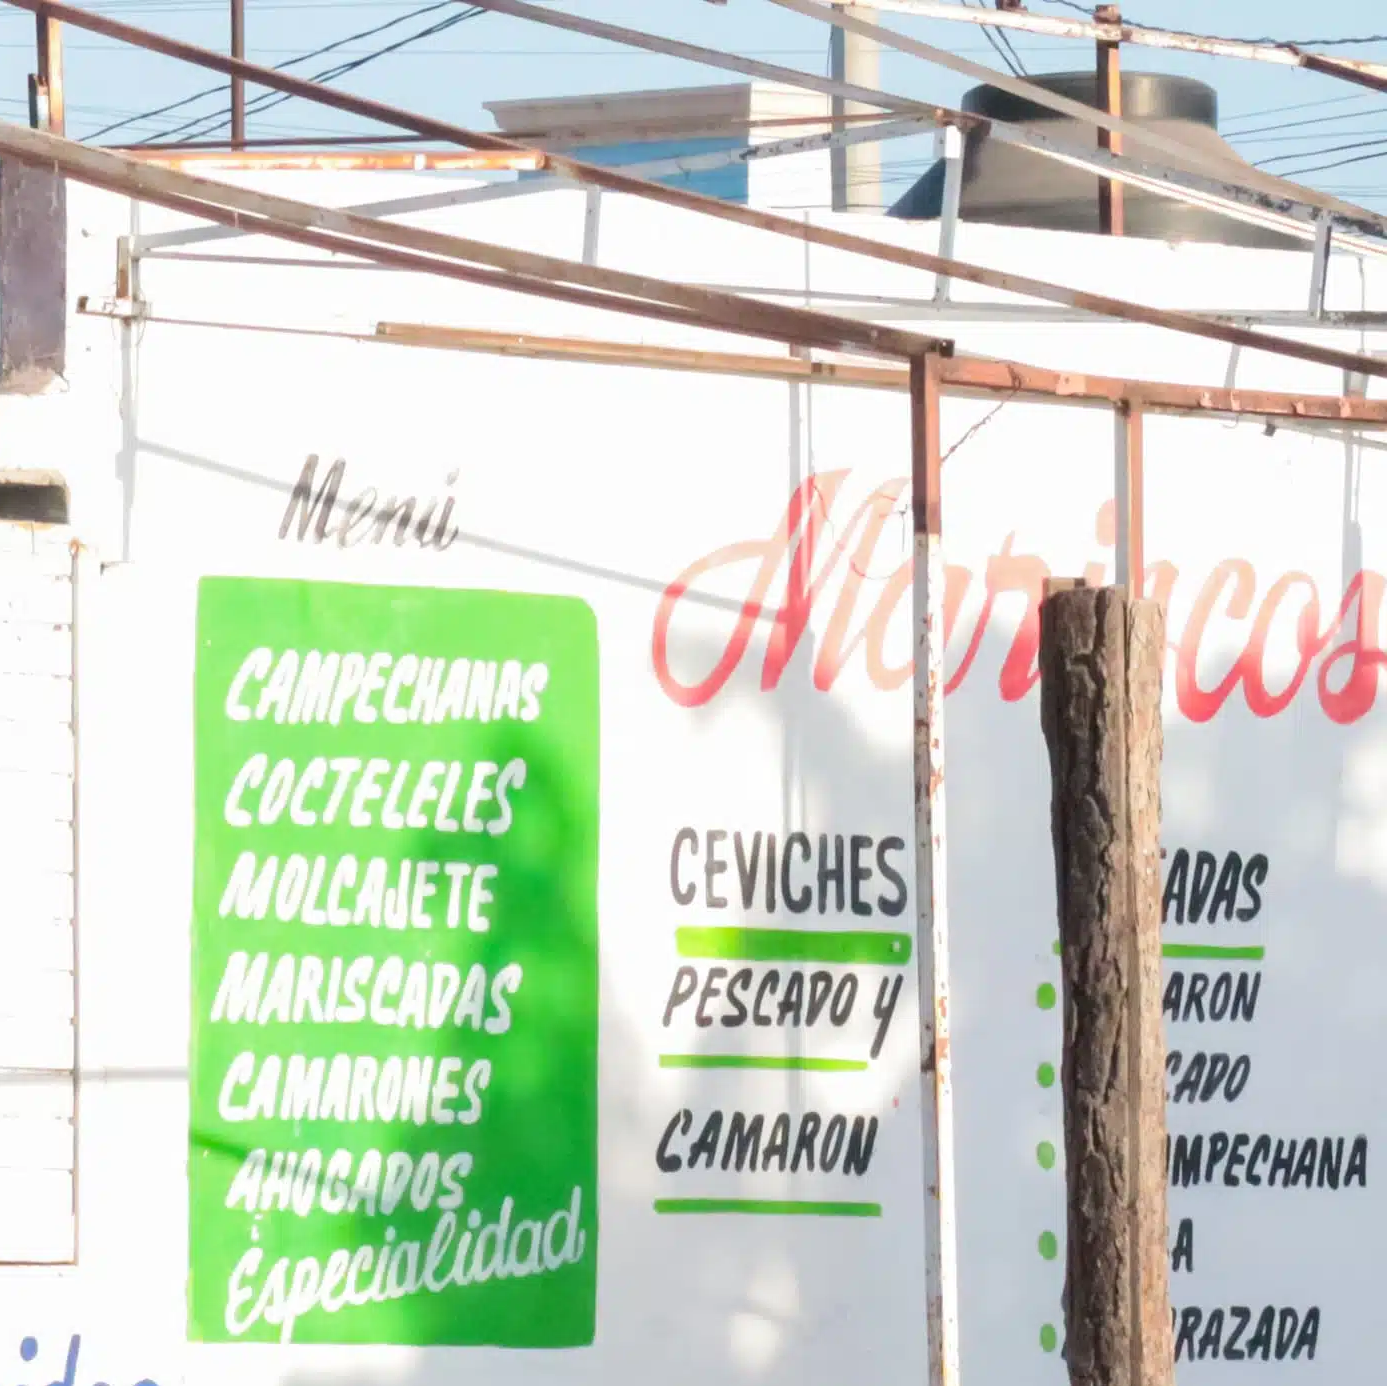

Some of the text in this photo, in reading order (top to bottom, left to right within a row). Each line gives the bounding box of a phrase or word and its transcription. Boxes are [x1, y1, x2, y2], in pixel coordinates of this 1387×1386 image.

[224, 646, 550, 726] CAMPECHANAS
[223, 752, 527, 836] COCTELELES
[218, 850, 498, 932] MOLCAJETE
[669, 827, 909, 917] CEVICHES
[209, 949, 523, 1034] MARISCADAS
[662, 966, 858, 1028] PESCADO
[218, 1050, 491, 1126] CAMARONES
[224, 1147, 473, 1216] AHOGADOS
[655, 1108, 879, 1177] CAMARON
[224, 1186, 585, 1346] Especialidad
